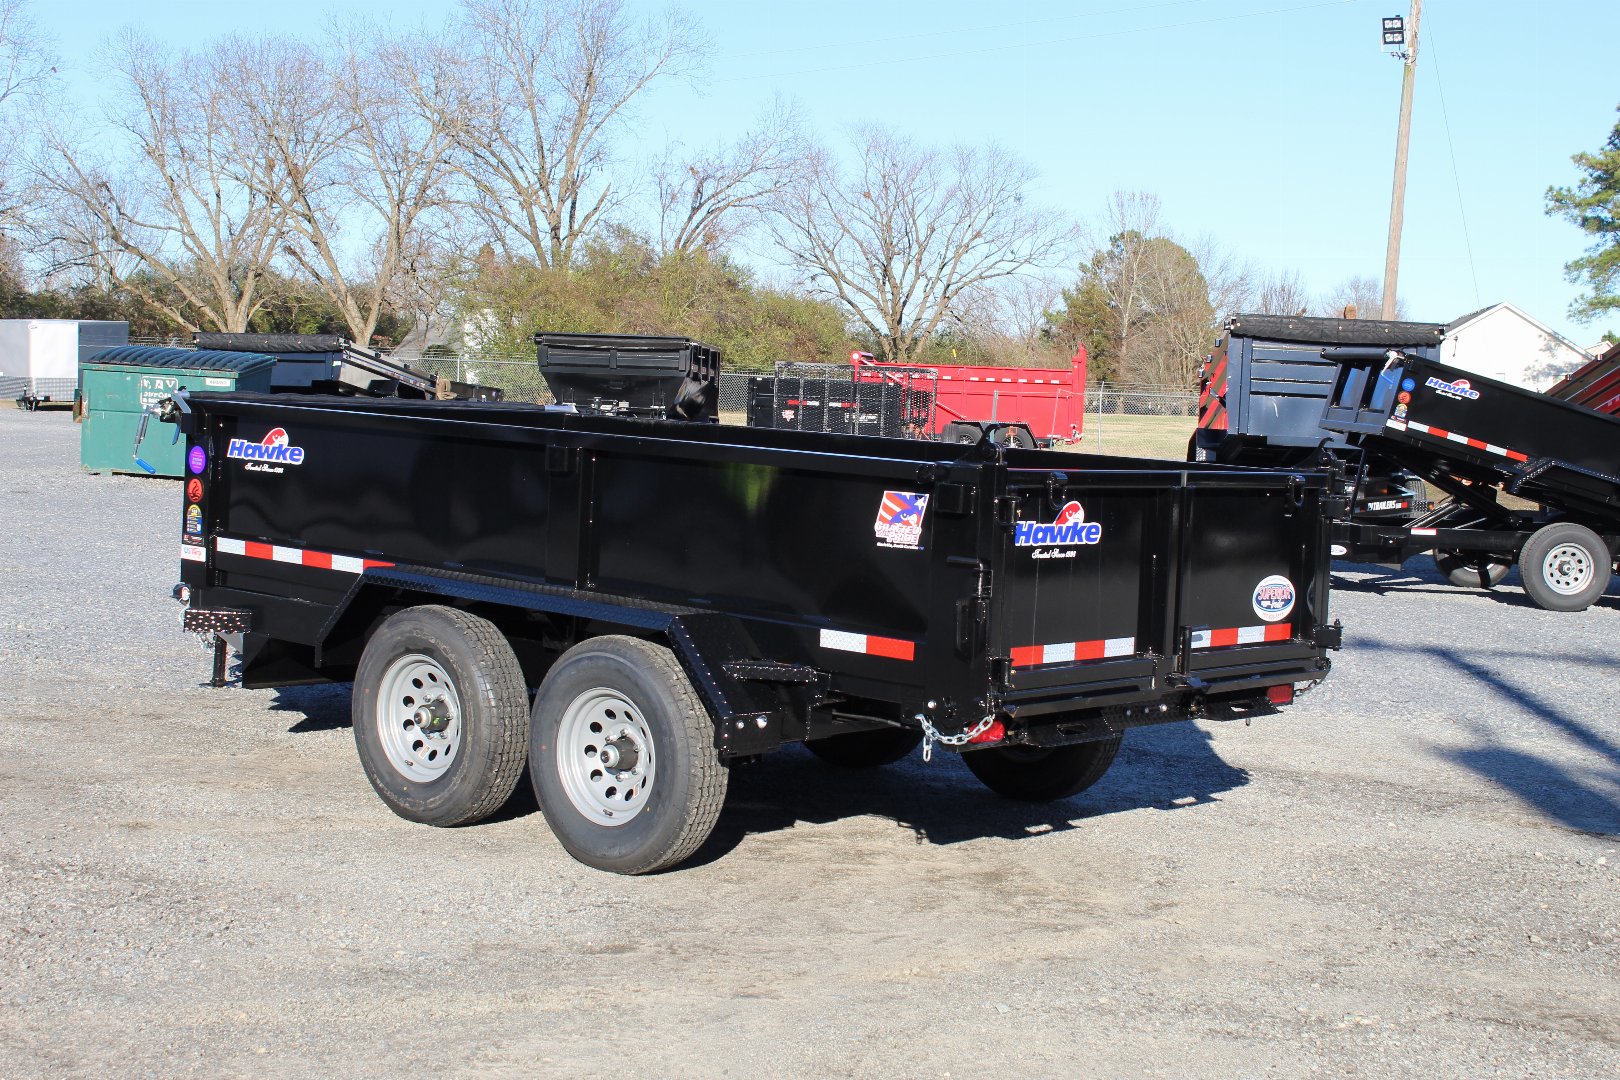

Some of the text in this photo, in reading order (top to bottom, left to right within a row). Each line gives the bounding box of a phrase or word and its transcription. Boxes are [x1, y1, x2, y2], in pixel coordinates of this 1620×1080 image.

[1425, 377, 1480, 400] Hawke
[228, 440, 304, 465] Hawke
[1015, 521, 1101, 546] Hawke
[1258, 584, 1291, 600] SUPERIOR
